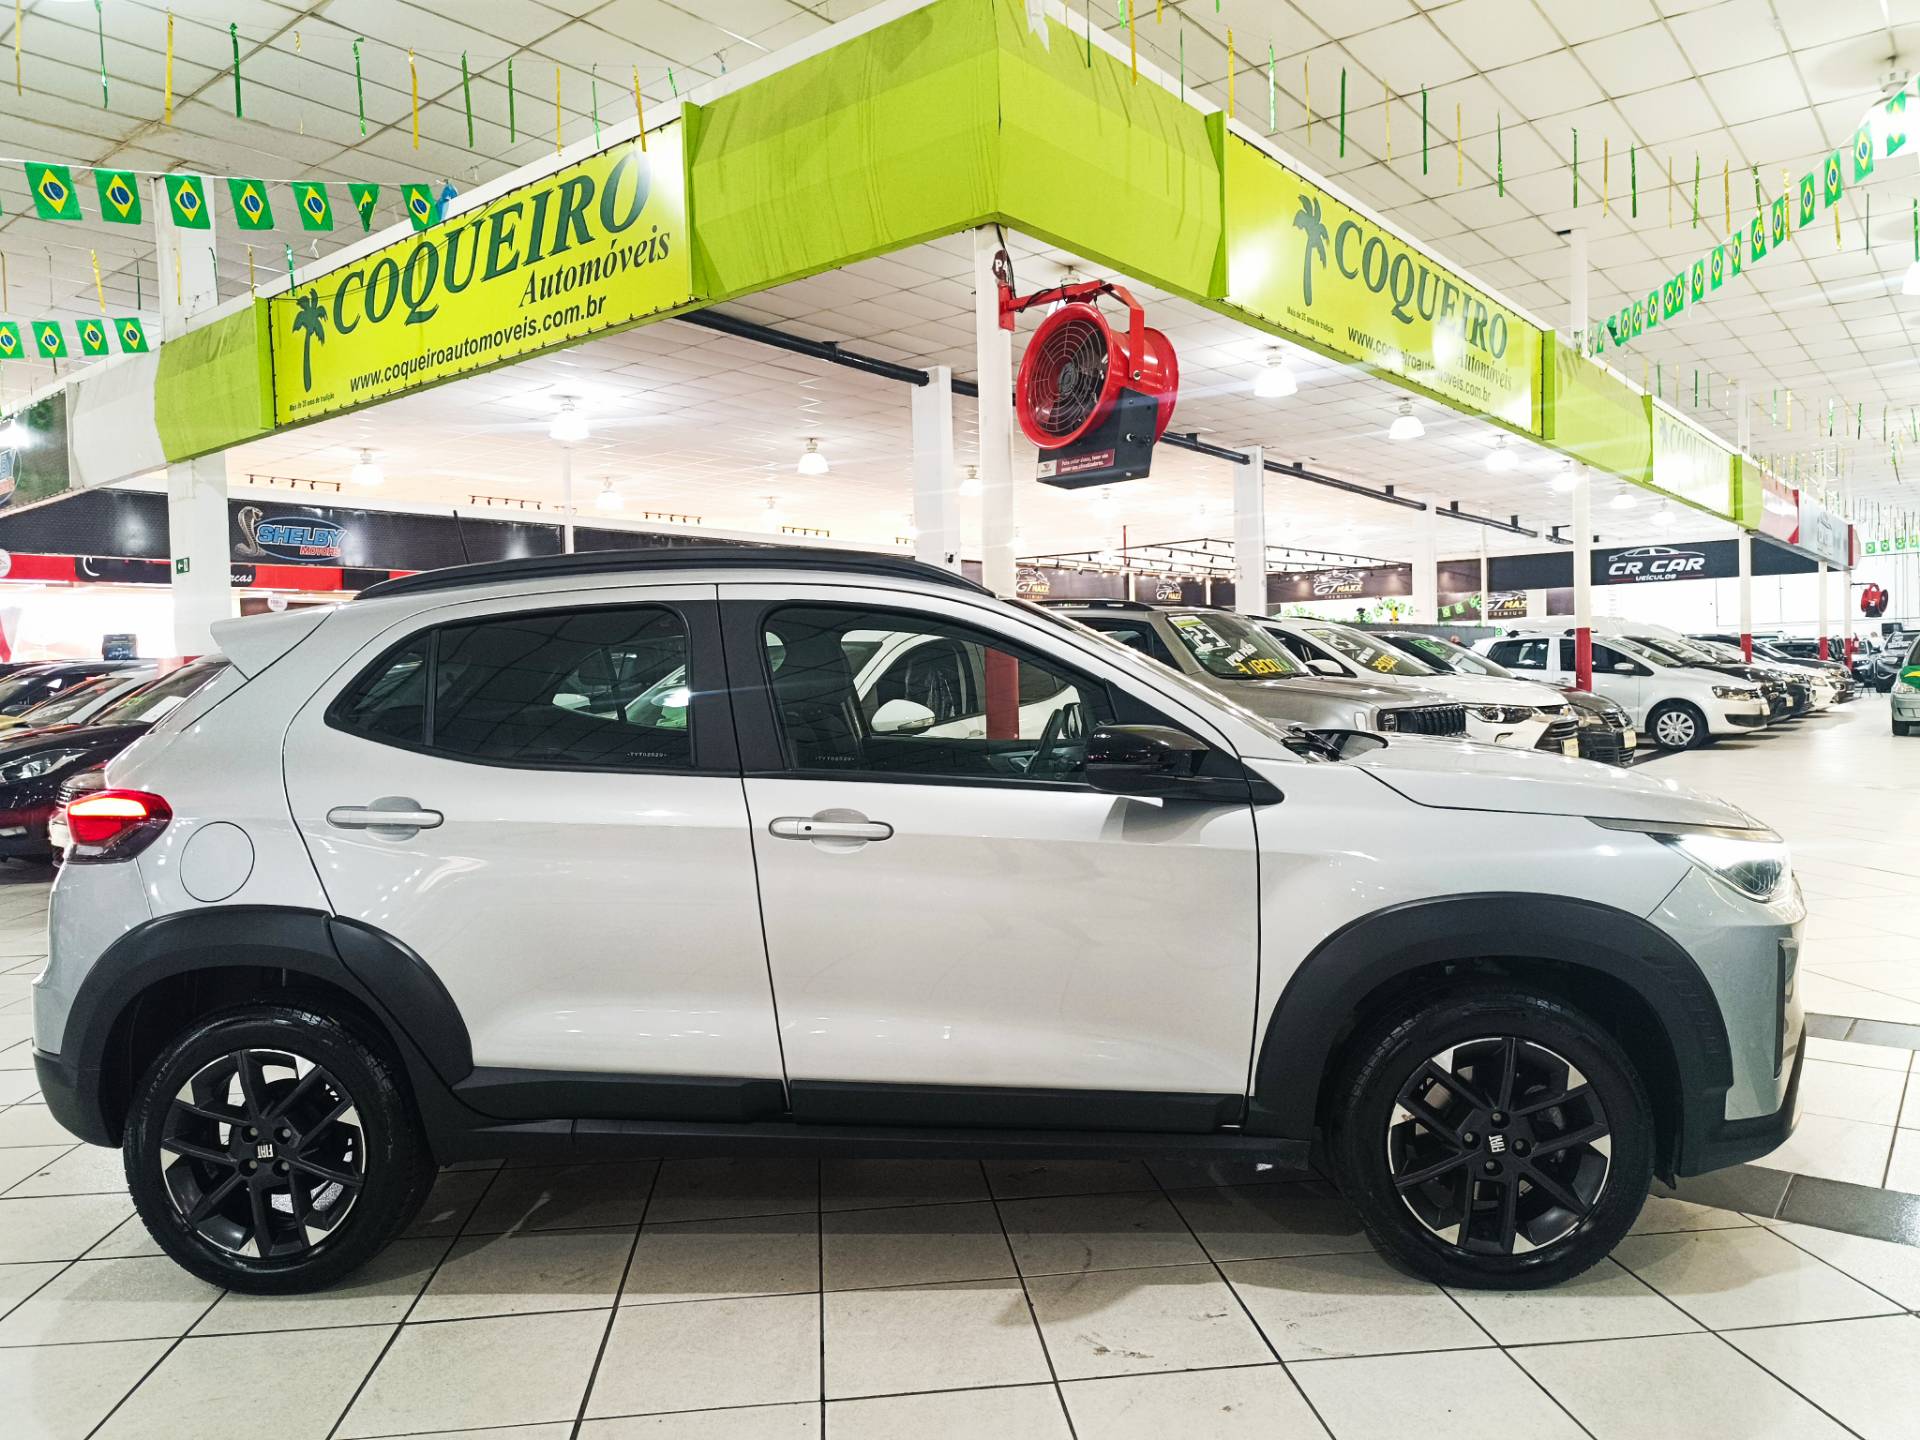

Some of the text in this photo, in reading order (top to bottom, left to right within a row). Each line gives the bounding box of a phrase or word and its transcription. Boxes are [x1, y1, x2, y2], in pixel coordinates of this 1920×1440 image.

[333, 151, 651, 335] COQUEIRO
[519, 225, 671, 308] Automóveis
[1335, 220, 1508, 359] COQUEIRO
[349, 294, 607, 392] www.coqueiroautomoveis.com.br
[257, 524, 347, 547] SHELBY
[300, 545, 342, 557] MOTORS
[1609, 557, 1705, 575] CR CAR
[257, 1143, 274, 1159] FIAT
[1488, 1134, 1506, 1153] FIAT
